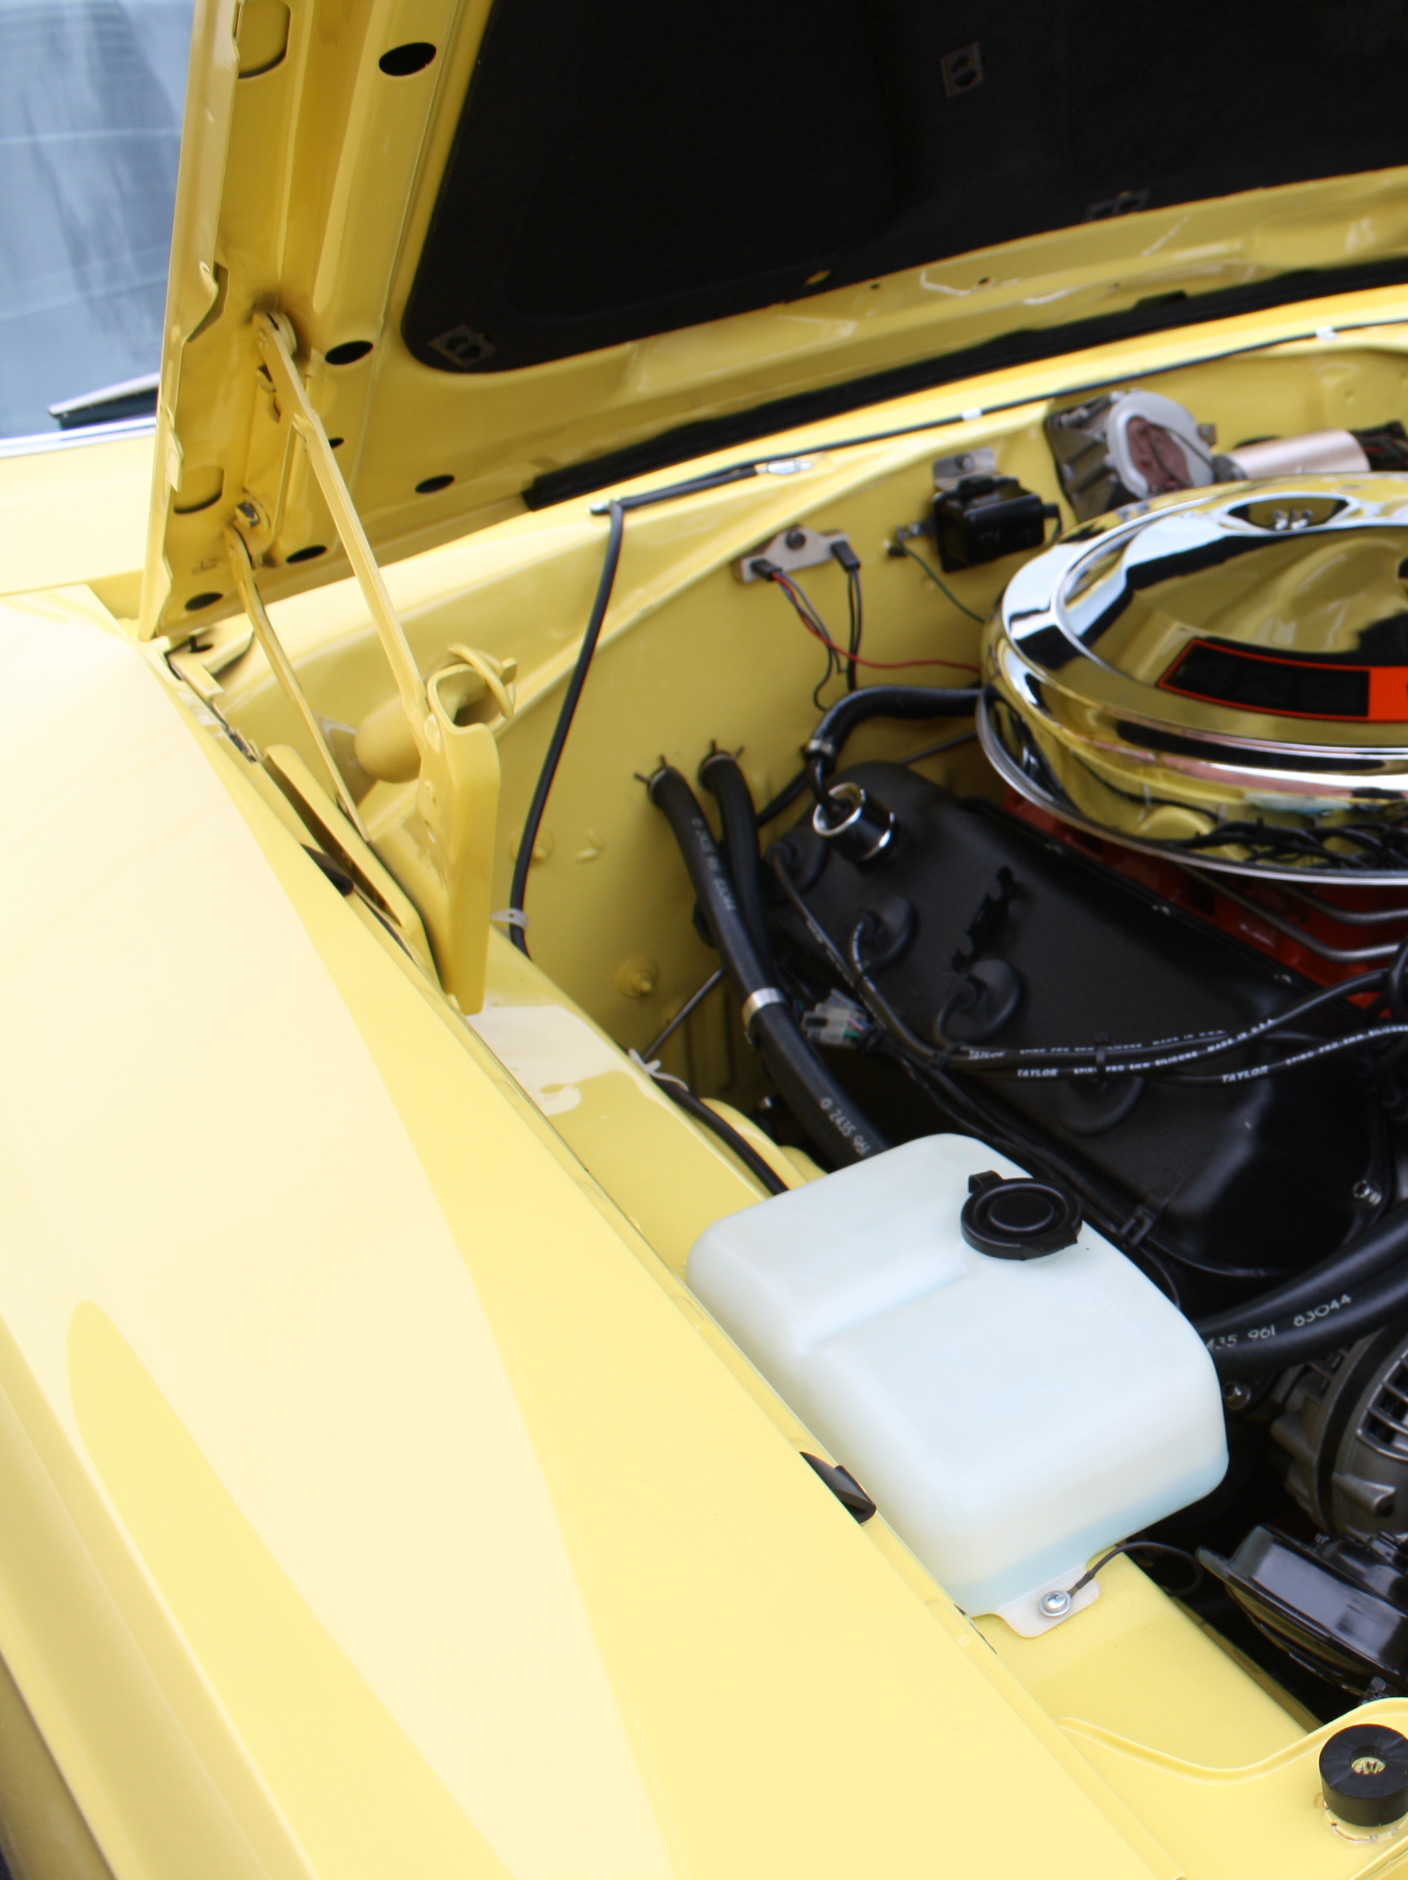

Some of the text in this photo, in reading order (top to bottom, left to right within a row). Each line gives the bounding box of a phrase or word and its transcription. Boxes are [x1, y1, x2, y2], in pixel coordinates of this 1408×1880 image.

[1016, 1067, 1060, 1079] TAYLOR
[1104, 1063, 1126, 1073] PRO
[1154, 1049, 1199, 1067] SILICONE
[1206, 1037, 1235, 1054] MADE
[1236, 1031, 1250, 1043] IN
[1221, 1064, 1270, 1084] TAYLOR
[1247, 1323, 1277, 1341] 961
